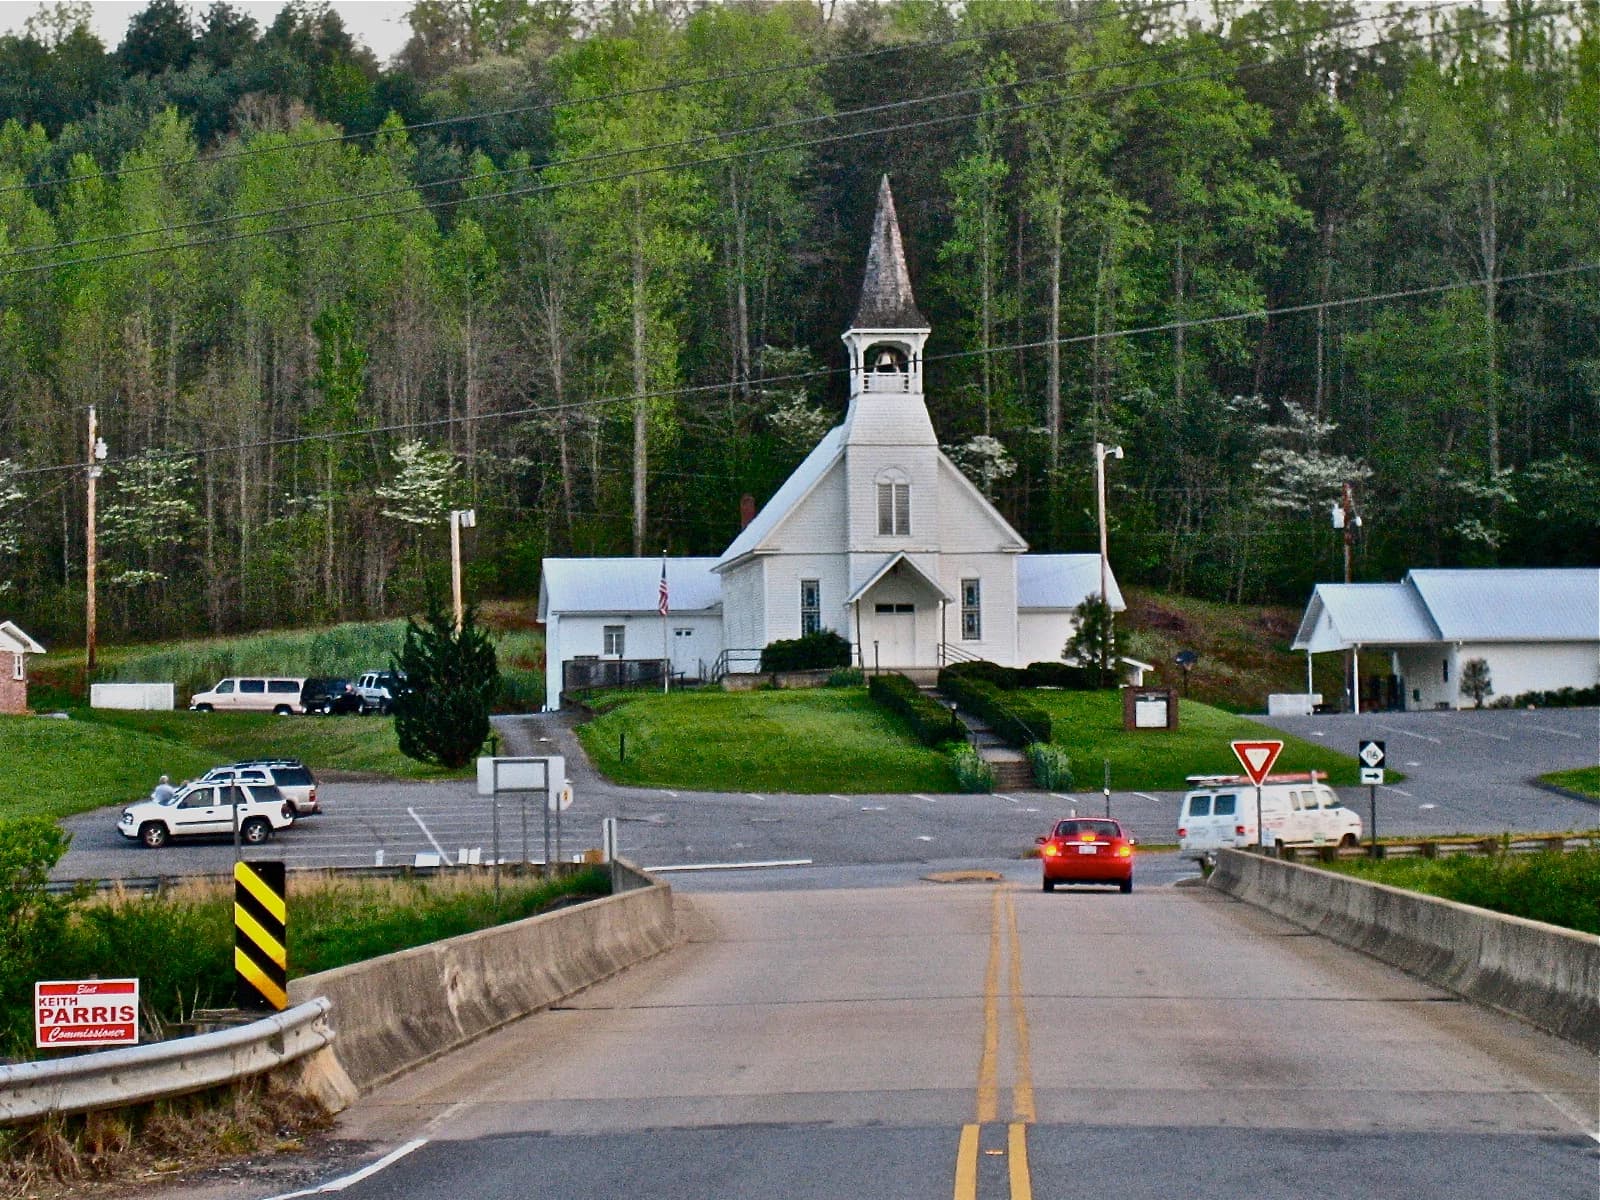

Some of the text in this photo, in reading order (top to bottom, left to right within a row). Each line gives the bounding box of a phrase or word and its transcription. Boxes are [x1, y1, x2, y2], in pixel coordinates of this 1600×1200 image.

[76, 985, 97, 994] Elect
[39, 997, 78, 1006] KEITH
[39, 1006, 135, 1024] PARRIS
[48, 1027, 126, 1041] Commissioner
